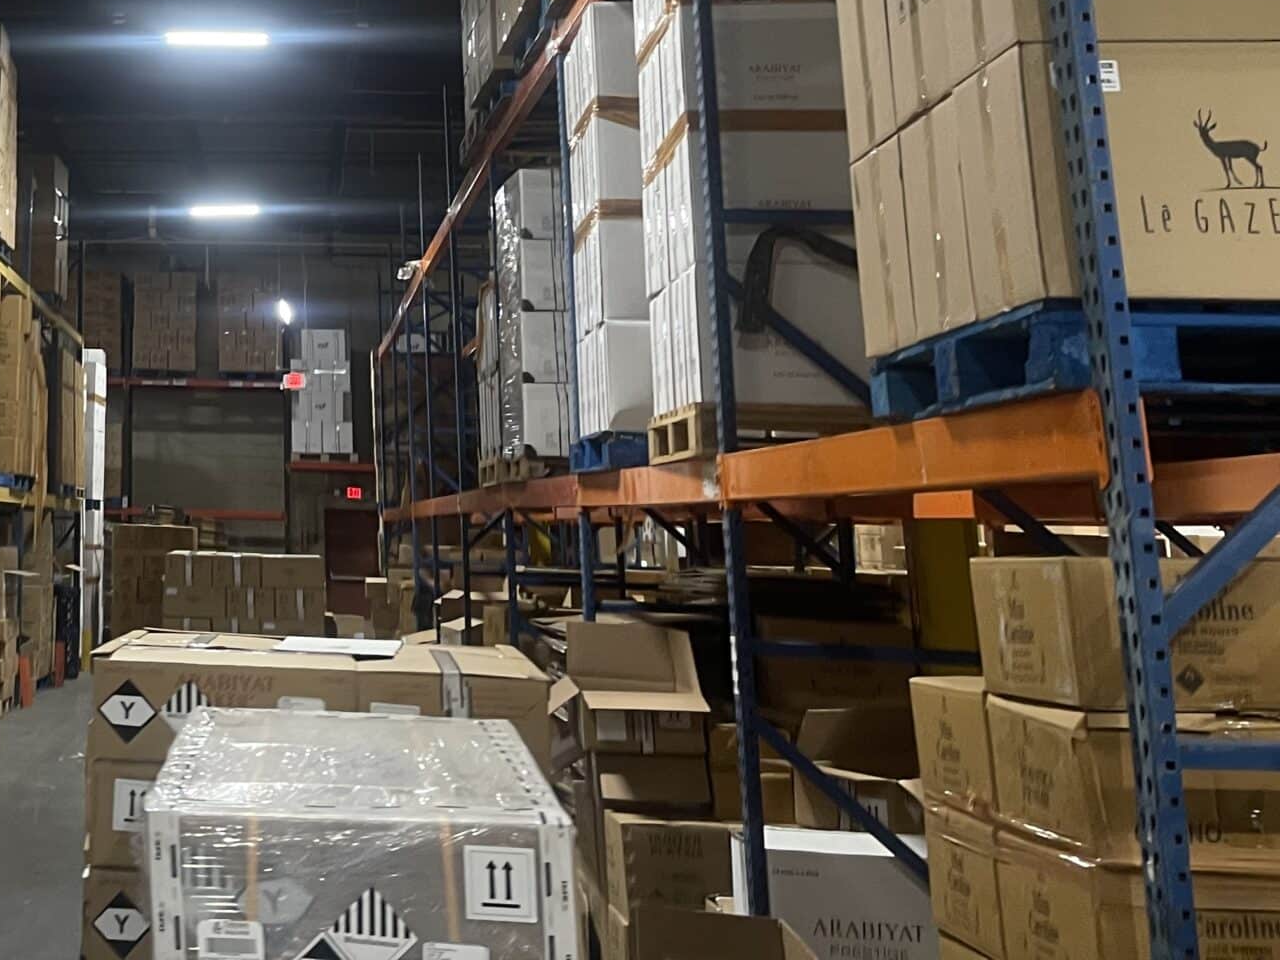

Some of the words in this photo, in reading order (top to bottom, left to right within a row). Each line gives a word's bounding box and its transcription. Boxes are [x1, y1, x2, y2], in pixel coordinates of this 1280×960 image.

[120, 700, 136, 721] Y
[114, 914, 130, 935] Y
[813, 917, 925, 945] ARABIYAT
